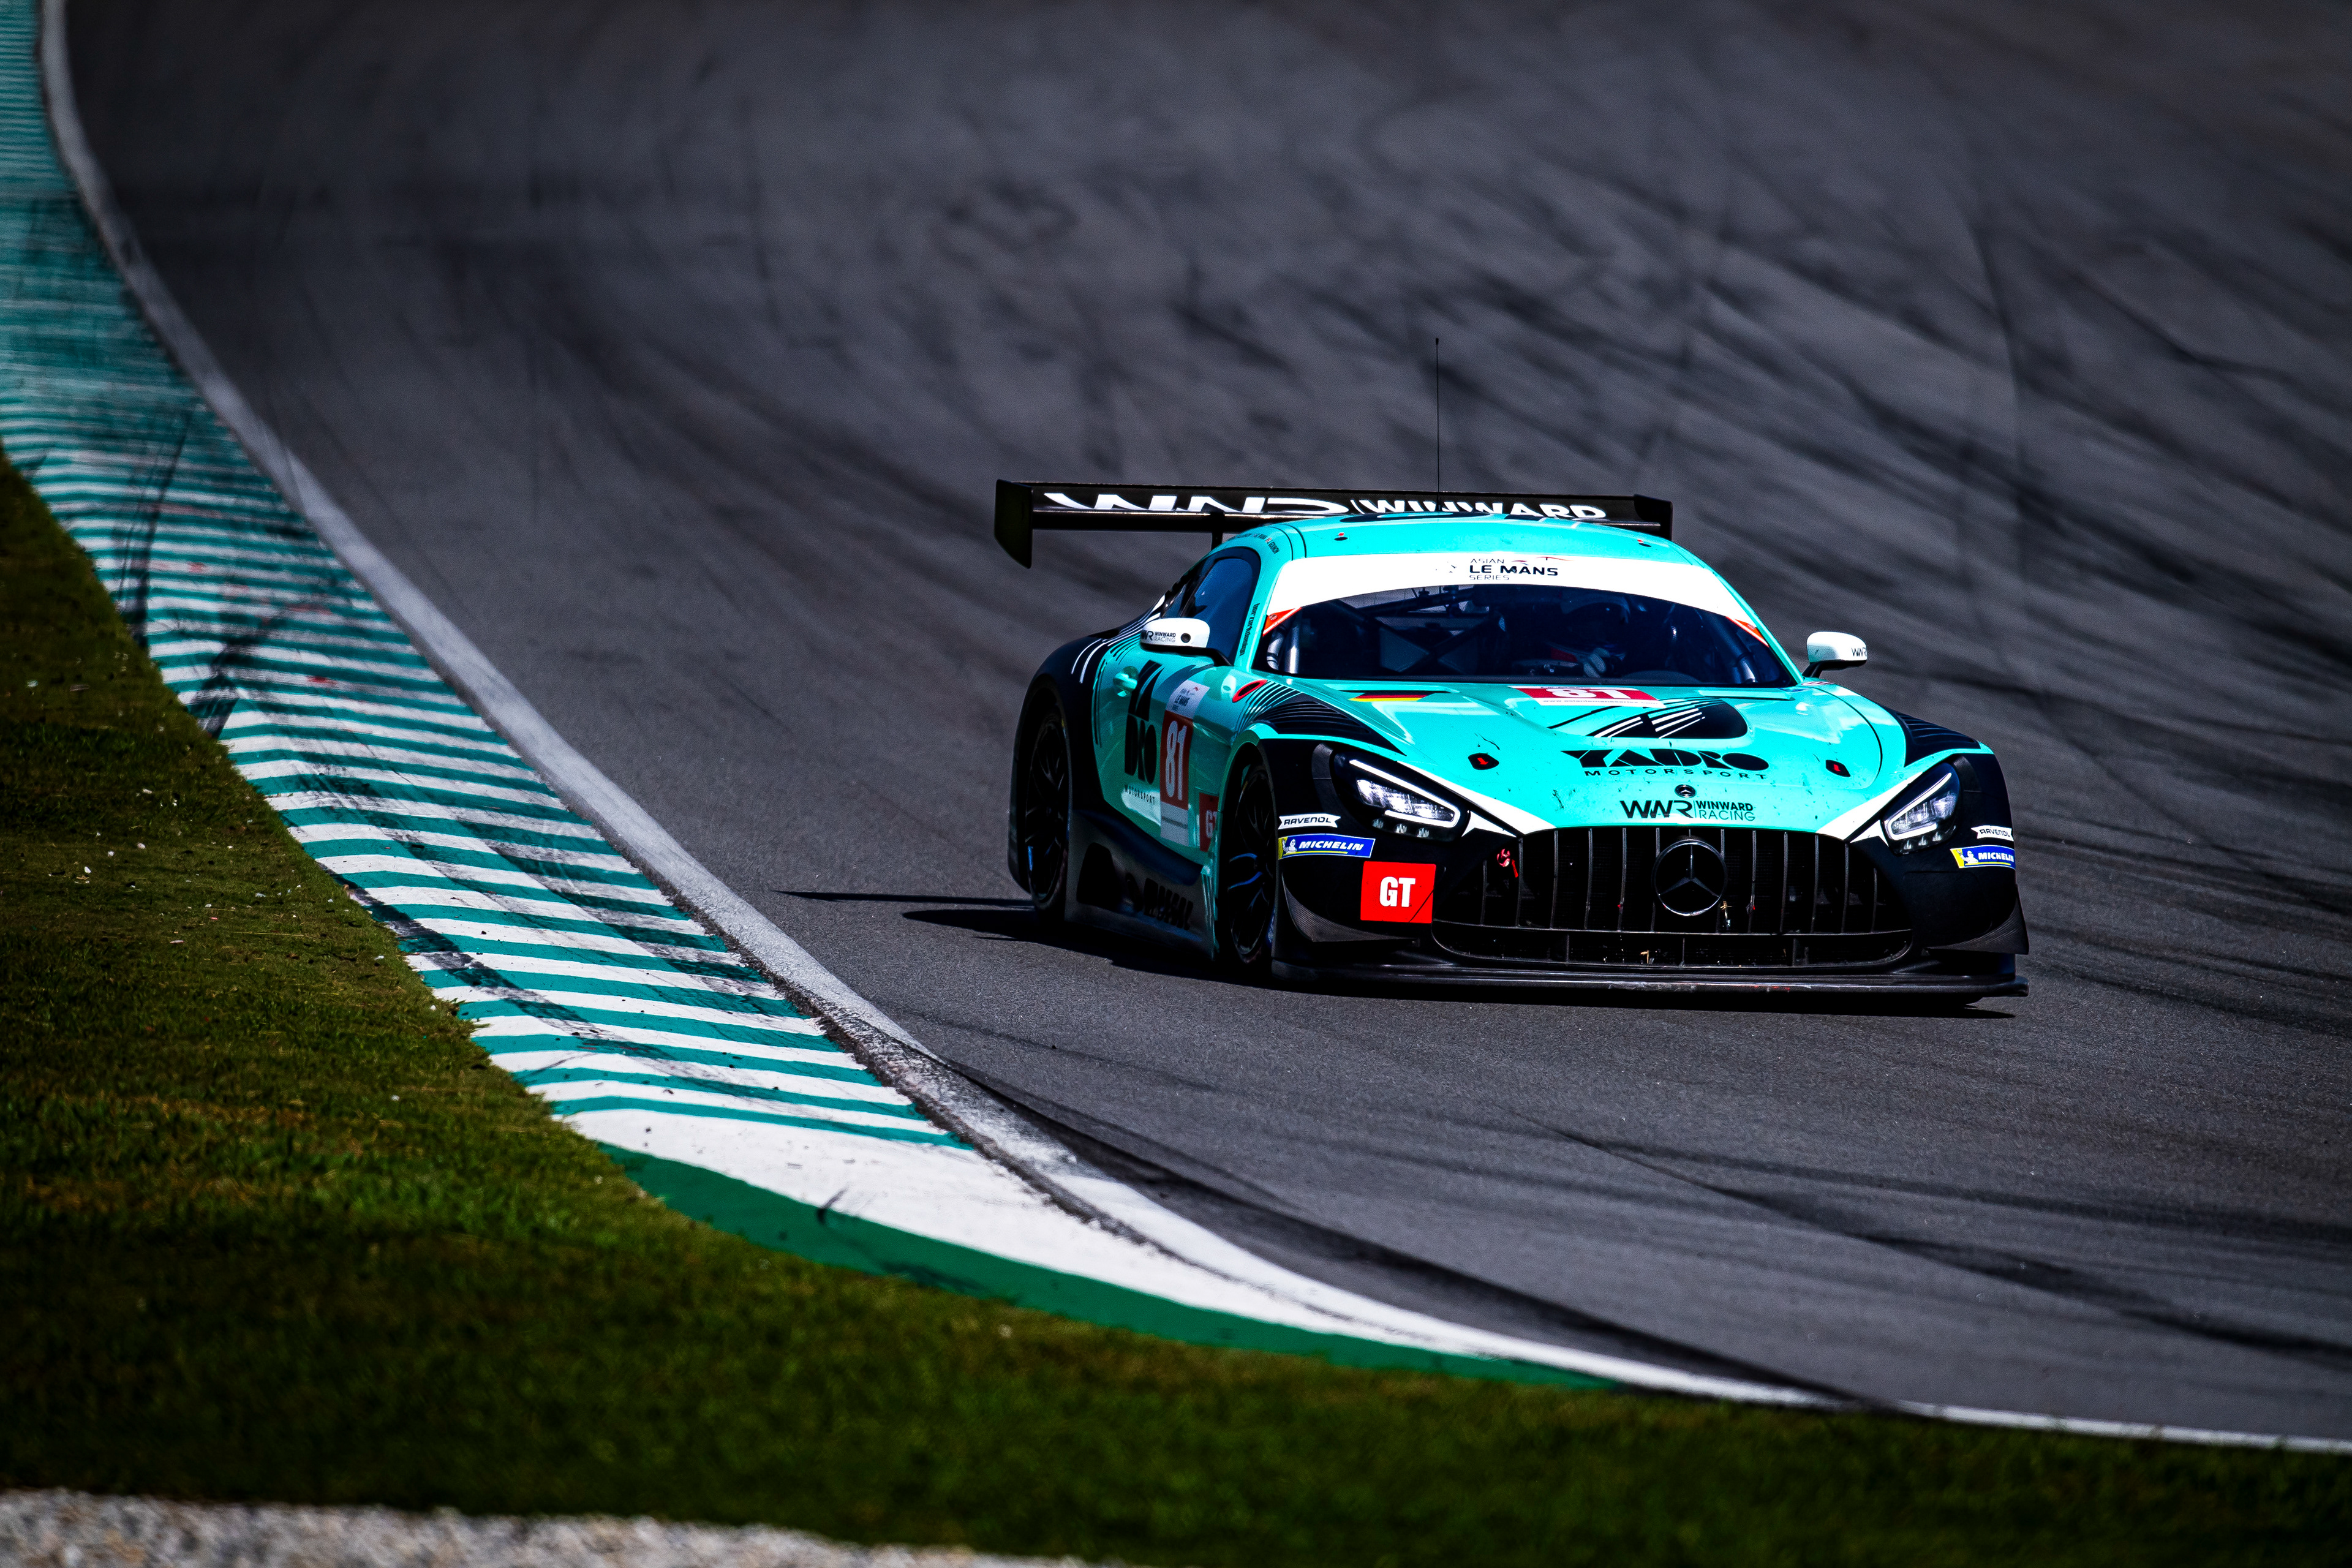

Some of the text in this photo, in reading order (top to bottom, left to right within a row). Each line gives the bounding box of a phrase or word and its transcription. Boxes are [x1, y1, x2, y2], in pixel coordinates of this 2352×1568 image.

[1469, 565, 1558, 576] LE MANS
[1546, 688, 1632, 699] 81
[1166, 720, 1188, 801] 81
[1585, 768, 1766, 780] MOTORSPORT
[1695, 801, 1753, 812] WINWARD
[1284, 816, 1332, 826] RAVENOL
[1698, 810, 1755, 821] RACING
[1979, 829, 2011, 837] RAVENOL
[1298, 840, 1364, 851] MICHELIN
[1978, 852, 2015, 862] MICHELIN
[1379, 876, 1415, 908] GT
